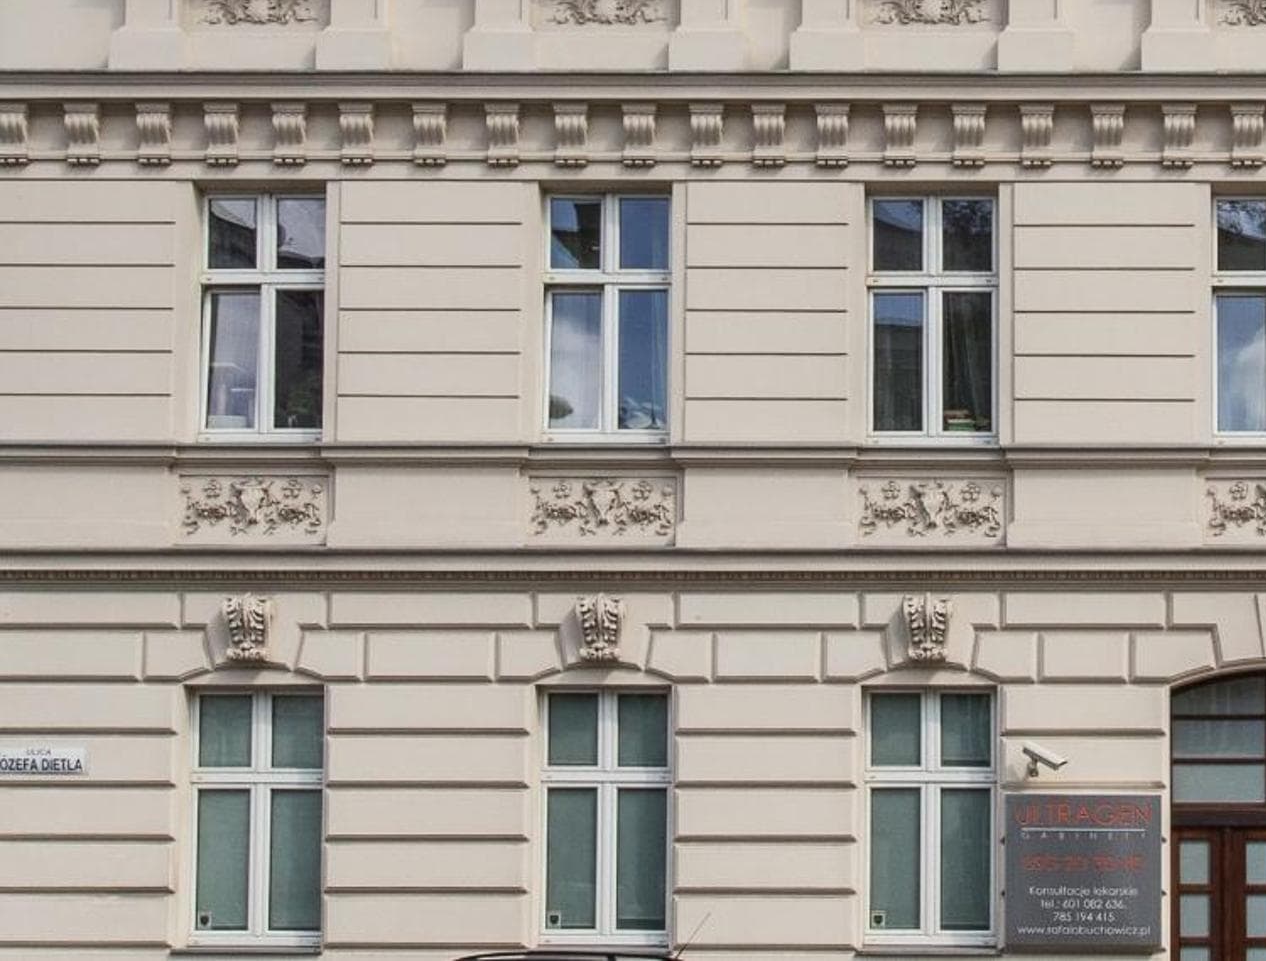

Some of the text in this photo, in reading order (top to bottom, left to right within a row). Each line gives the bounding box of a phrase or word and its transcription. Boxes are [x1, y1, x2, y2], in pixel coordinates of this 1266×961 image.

[0, 755, 83, 771] ÓZEFA DIETLA
[1014, 804, 1152, 825] ULTRAGEN
[1028, 885, 1139, 897] Konsultacje lekarskie
[1062, 900, 1081, 909] 601
[1053, 912, 1115, 922] 785 194 415
